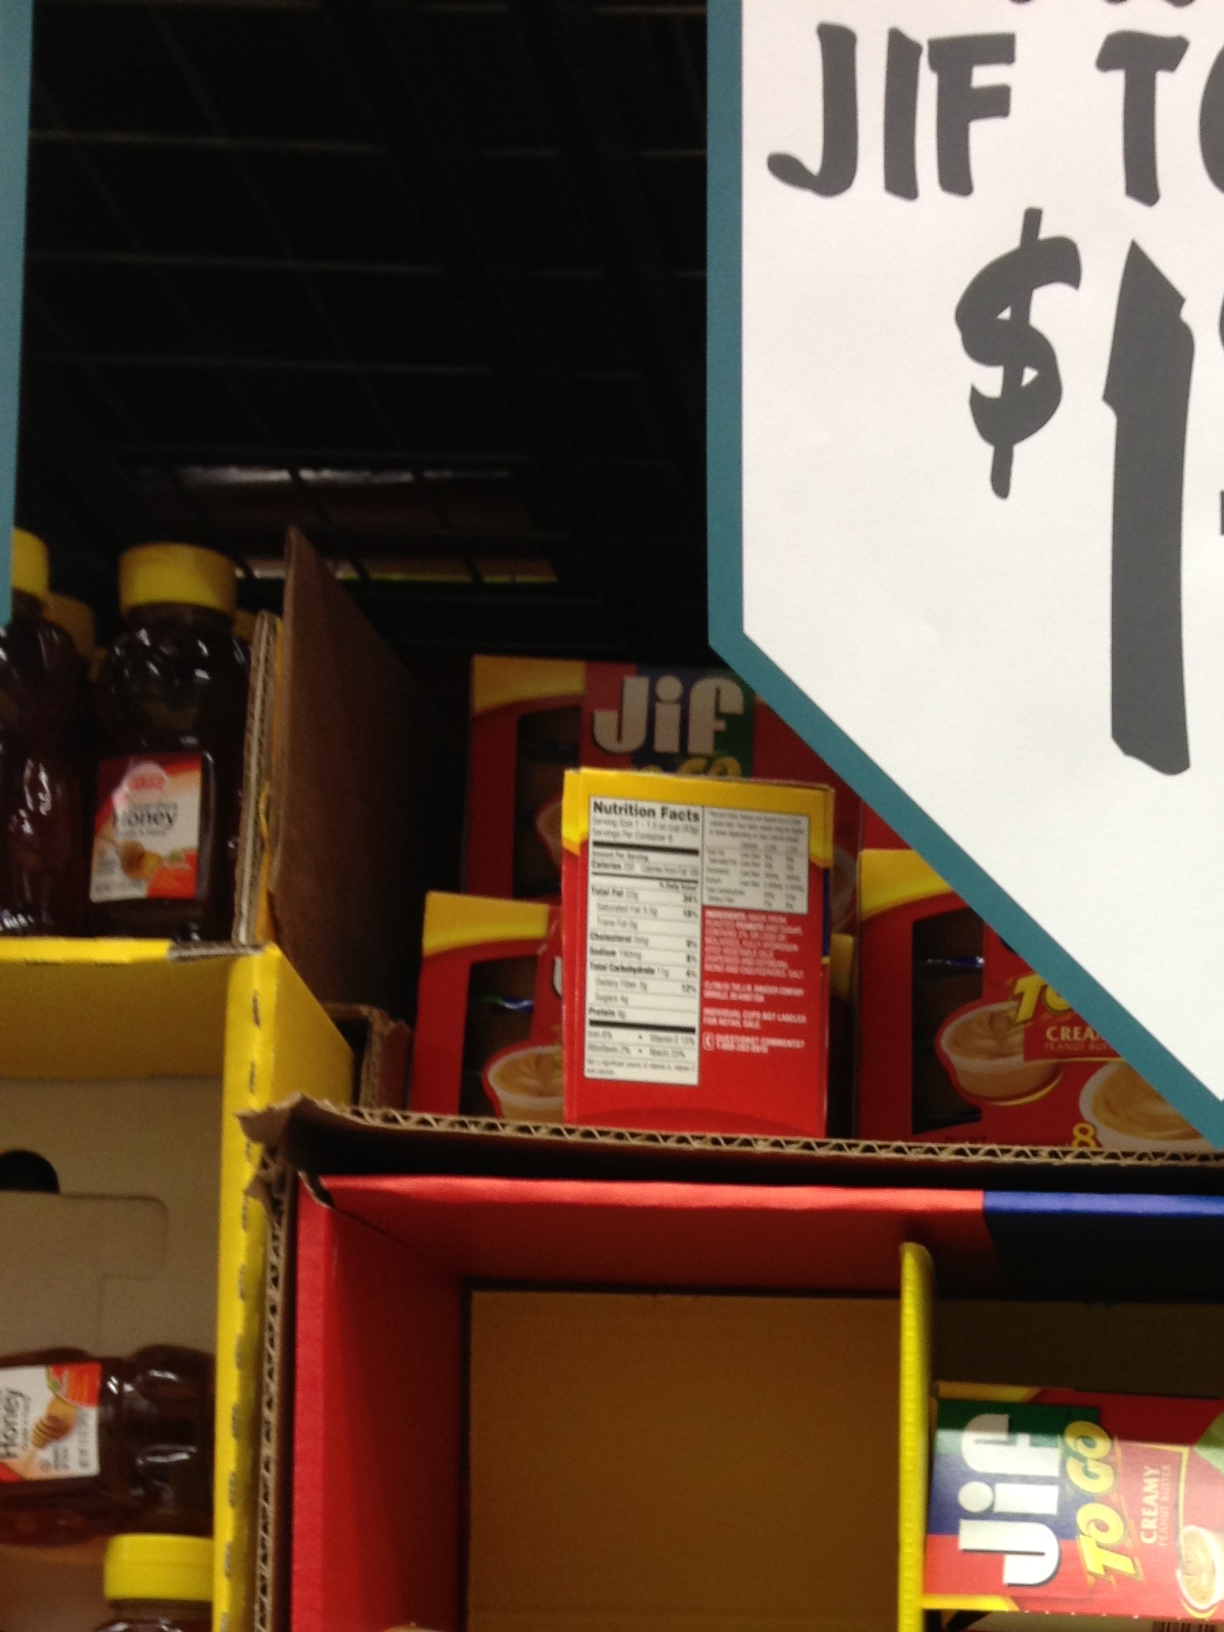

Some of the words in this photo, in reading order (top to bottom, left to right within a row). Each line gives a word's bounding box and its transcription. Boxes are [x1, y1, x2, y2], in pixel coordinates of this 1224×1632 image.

[767, 22, 1016, 200] JIF
[593, 675, 744, 754] Jif
[593, 801, 656, 818] Nutrition
[661, 807, 700, 822] Facts
[1063, 1419, 1118, 1494] GO
[958, 1412, 1061, 1587] Jif
[1140, 1464, 1162, 1545] CREAMY
[1076, 1501, 1141, 1582] TO
